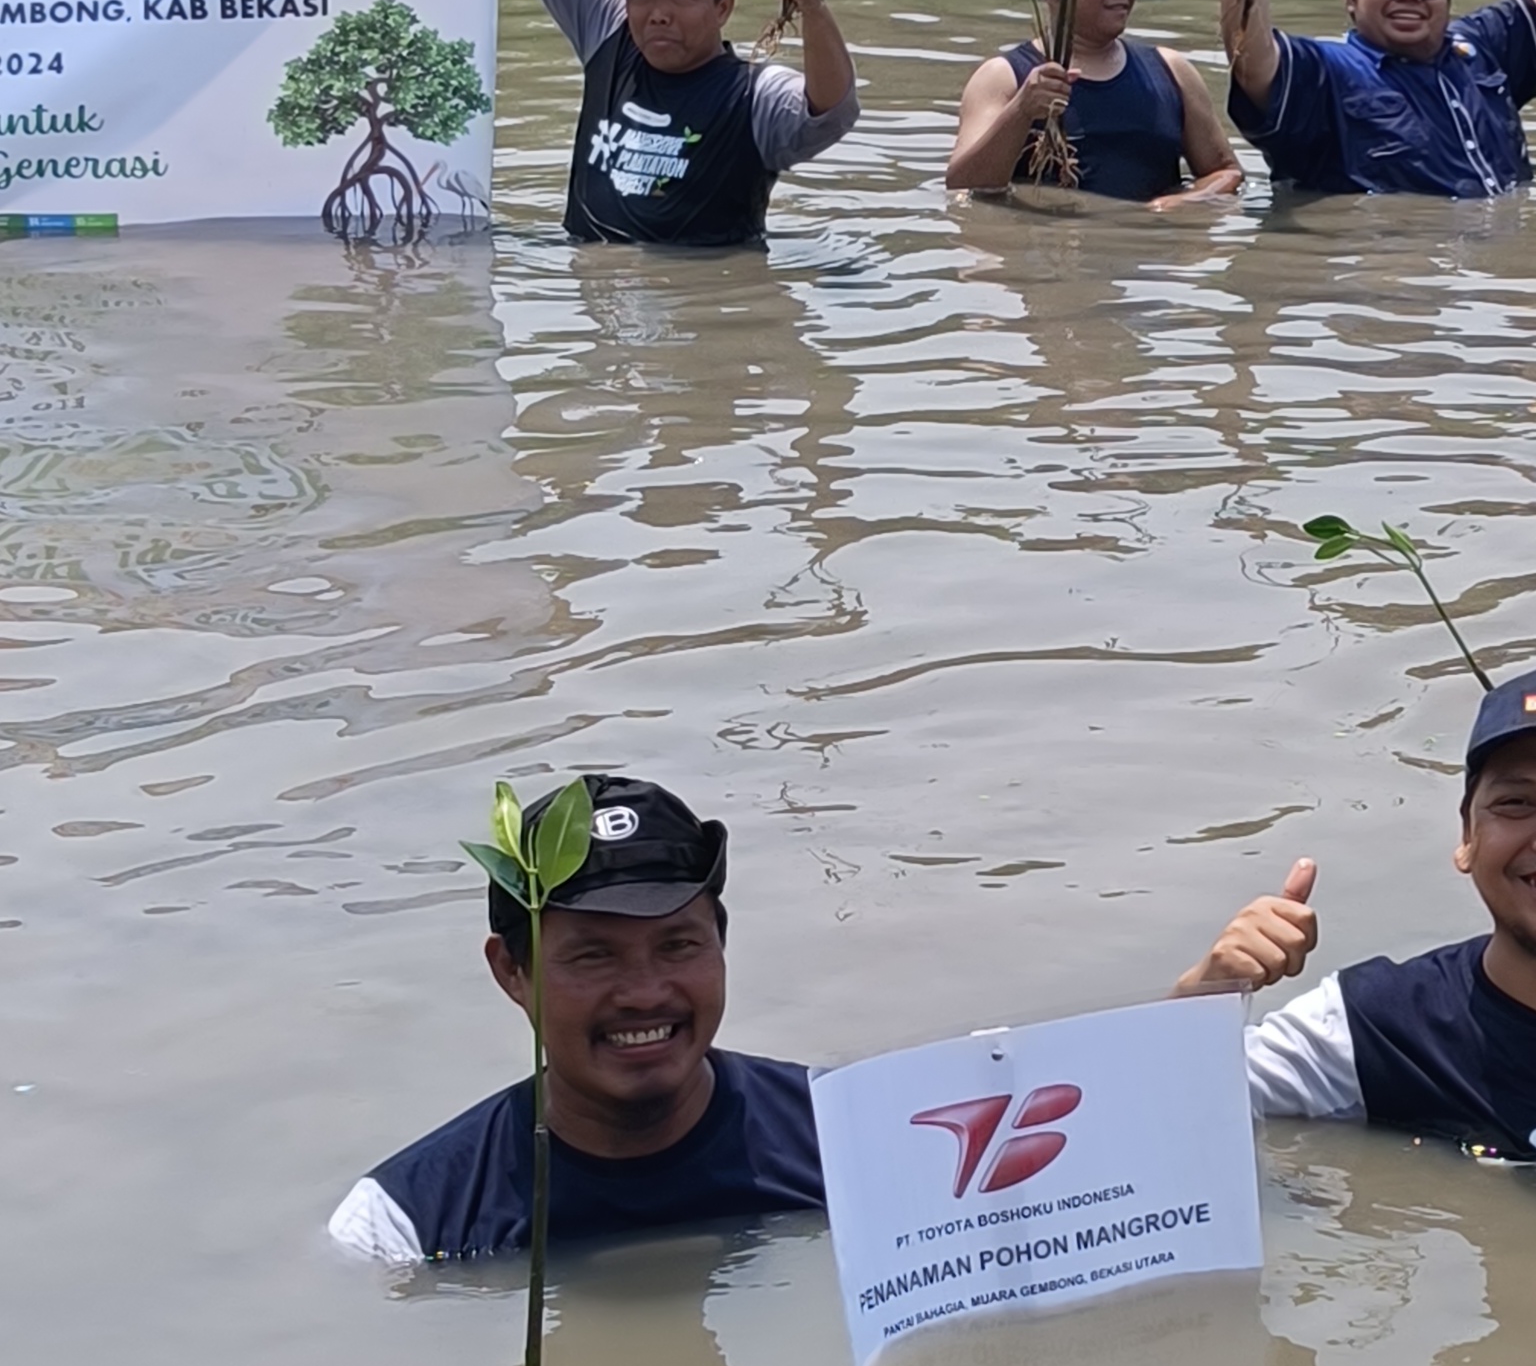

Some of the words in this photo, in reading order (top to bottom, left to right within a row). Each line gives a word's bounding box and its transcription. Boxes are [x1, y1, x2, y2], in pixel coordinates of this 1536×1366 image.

[0, 51, 64, 76] 024
[917, 1218, 975, 1243] TOYOTA
[977, 1201, 1054, 1228] BOSHOKU
[1056, 1183, 1135, 1212] INDONESIA
[859, 1254, 972, 1316] PENANAMAN
[978, 1234, 1070, 1271] POHON
[1075, 1202, 1212, 1252] MANGROVE
[883, 1314, 916, 1338] PANTAI
[970, 1287, 1018, 1308] MUARA
[1019, 1273, 1089, 1298] GEMBONG,
[1090, 1261, 1134, 1283] BEKASI
[1135, 1250, 1176, 1271] UTARA
